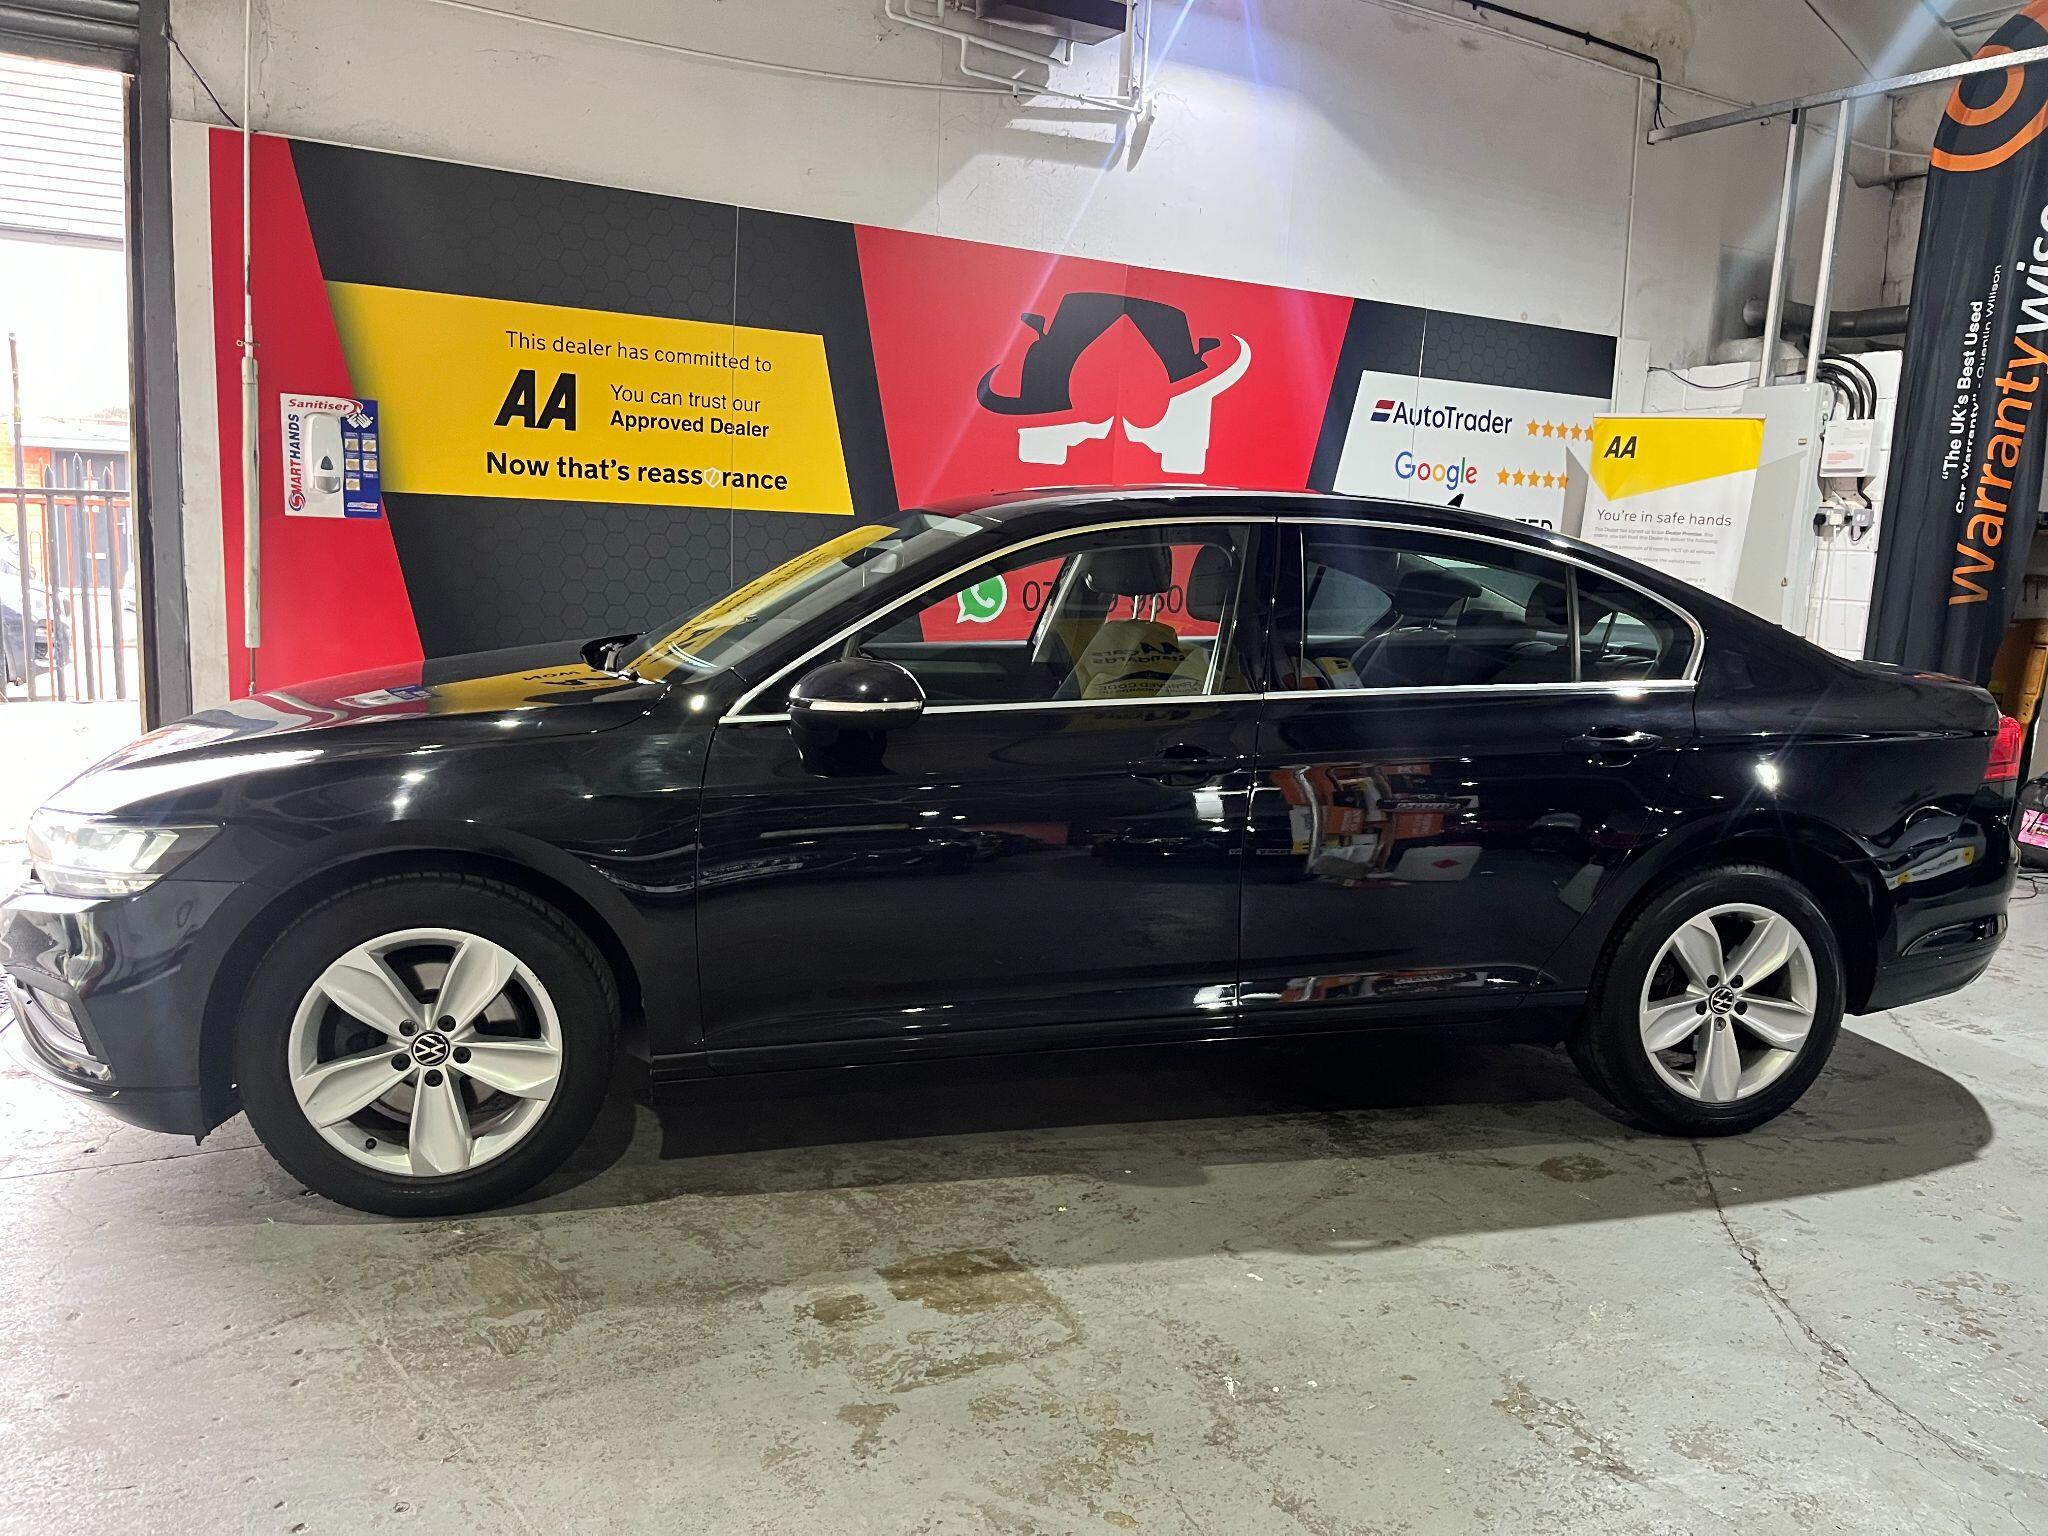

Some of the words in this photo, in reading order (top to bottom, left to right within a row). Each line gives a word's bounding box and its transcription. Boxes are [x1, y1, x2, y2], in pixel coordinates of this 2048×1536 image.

[1964, 301, 1983, 345] Used
[505, 330, 546, 351] This
[552, 336, 612, 357] dealer
[617, 342, 649, 361] has
[655, 349, 749, 372] committed
[755, 357, 772, 373] to
[1957, 350, 1975, 390] Best
[288, 398, 350, 412] Sanitiser
[494, 368, 577, 431] AA
[610, 383, 646, 403] You
[650, 390, 682, 406] can
[688, 391, 727, 410] trust
[732, 397, 761, 413] our
[1949, 394, 1969, 434] UK's
[610, 410, 704, 433] Approved
[710, 418, 769, 438] Dealer
[1392, 401, 1513, 435] AutoTrader
[1955, 483, 1967, 513] Car
[1976, 321, 1992, 379] Quentin
[1603, 435, 1638, 459] AA
[486, 451, 550, 477] Now
[556, 456, 630, 482] that's
[1395, 451, 1478, 491] Google
[1597, 508, 1637, 522] You're
[1641, 510, 1653, 523] in
[1656, 512, 1685, 525] safe
[1689, 514, 1732, 527] hands
